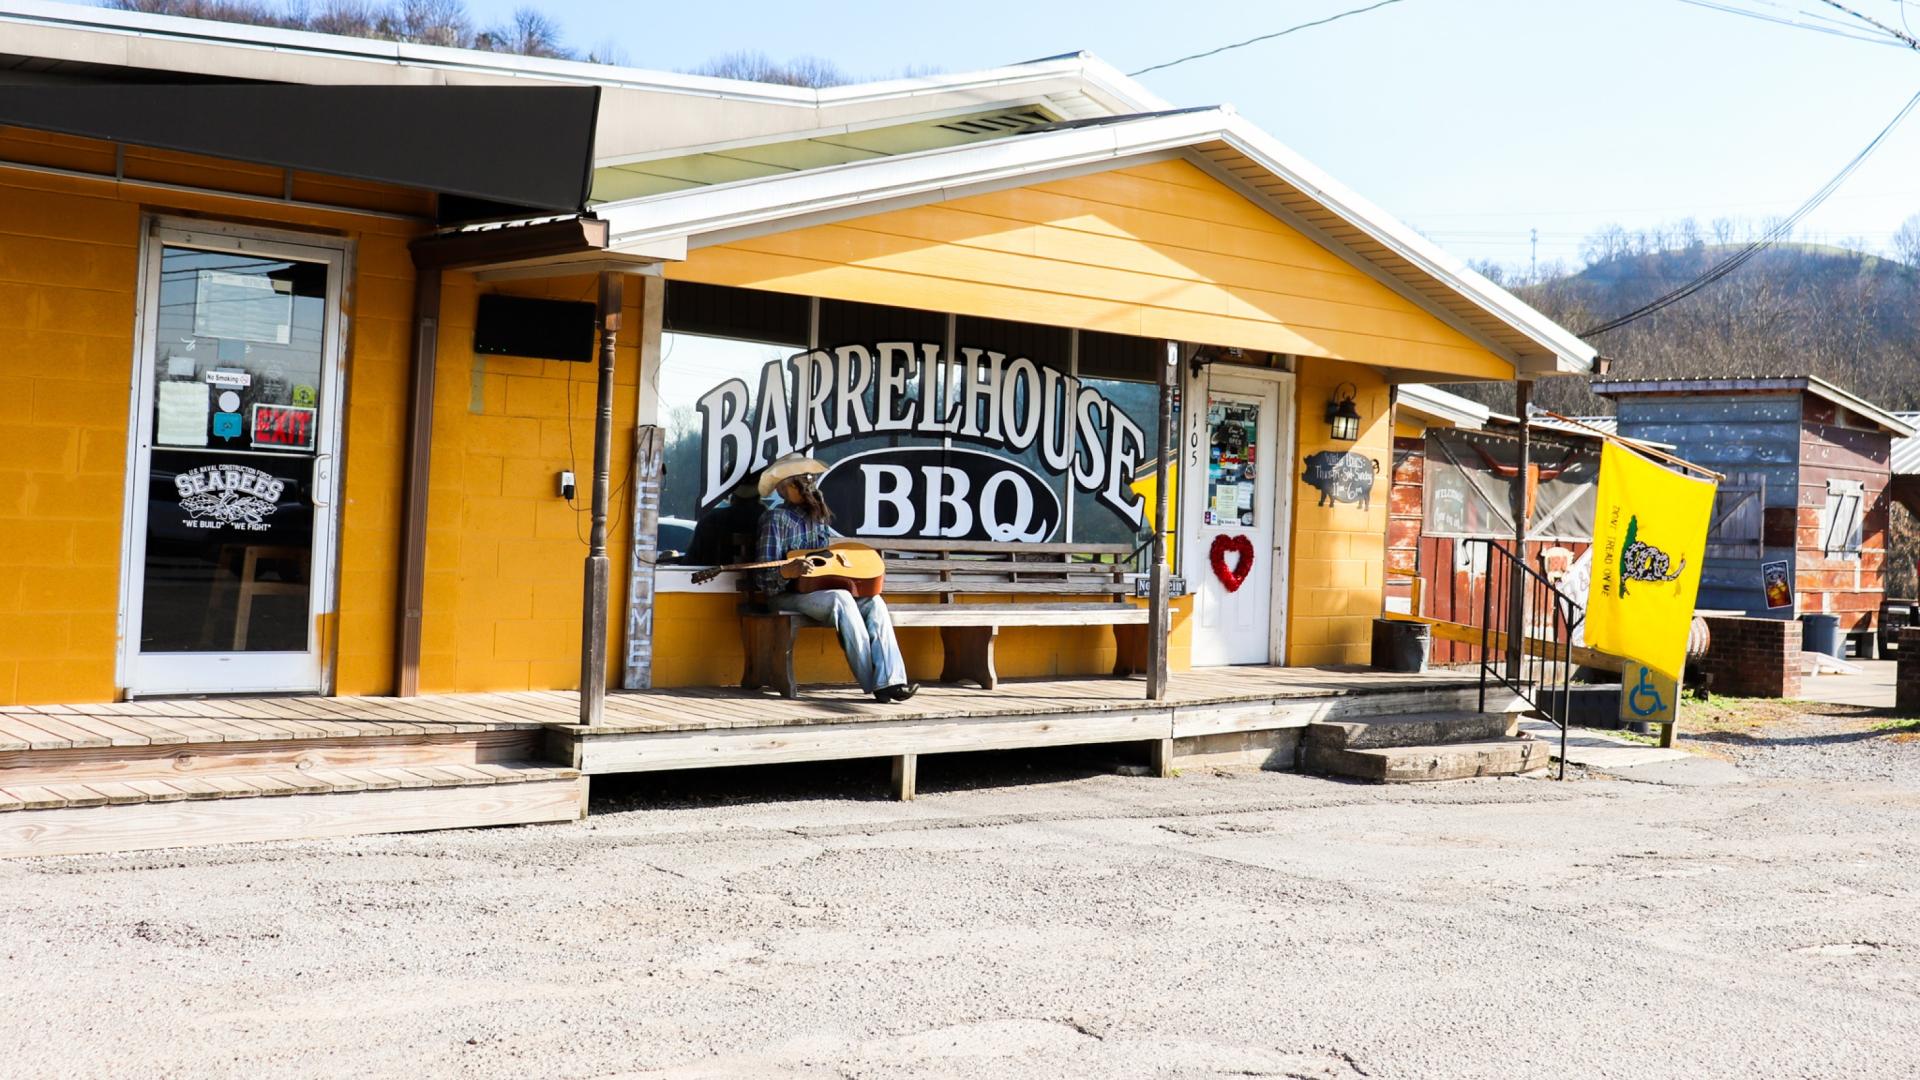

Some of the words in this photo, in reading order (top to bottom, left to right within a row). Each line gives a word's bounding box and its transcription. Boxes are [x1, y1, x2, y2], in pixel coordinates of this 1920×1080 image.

[215, 374, 239, 384] Smoking
[255, 407, 311, 445] EXIT
[698, 341, 1145, 530] BARRELHOUSE
[1190, 412, 1199, 467] 105
[174, 471, 284, 503] SEABEES
[188, 468, 199, 476] U.S.
[200, 465, 218, 473] NAVAL
[219, 464, 256, 475] CONSTRUCTION
[256, 469, 273, 480] FORCE
[856, 463, 1047, 543] BBQ
[628, 450, 660, 667] WELCOME
[1604, 536, 1617, 565] TREAD
[1602, 568, 1613, 582] ON
